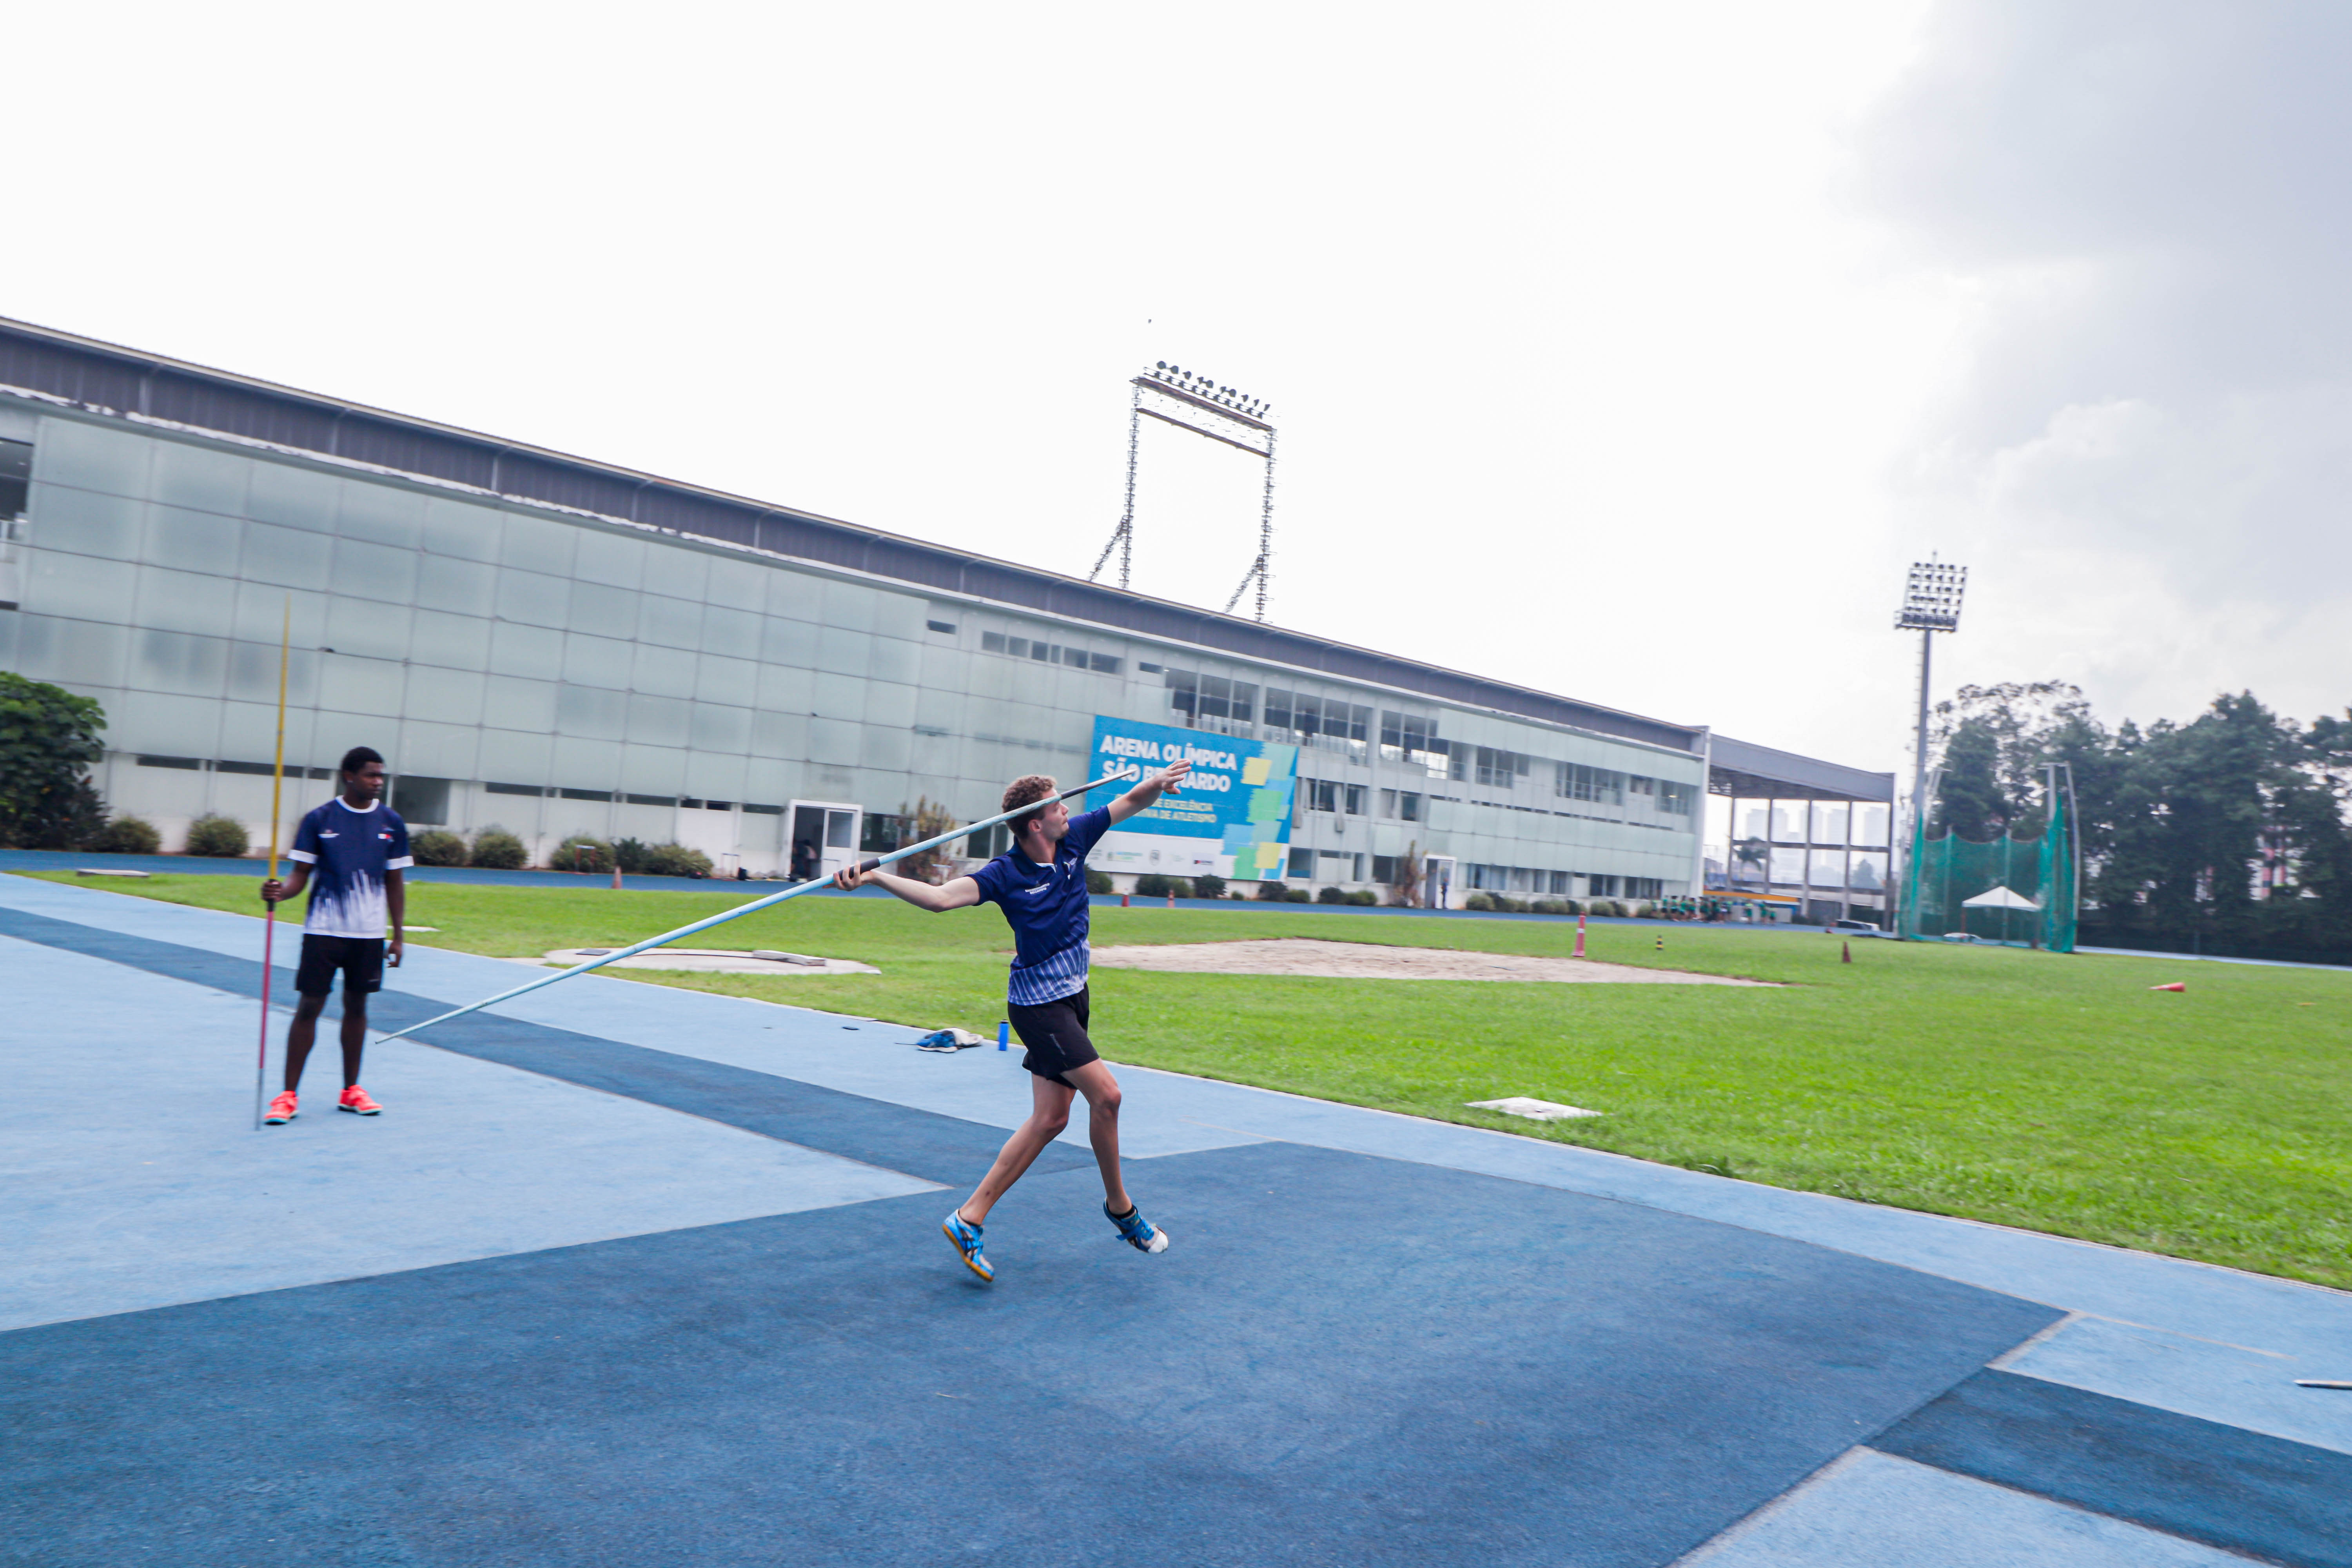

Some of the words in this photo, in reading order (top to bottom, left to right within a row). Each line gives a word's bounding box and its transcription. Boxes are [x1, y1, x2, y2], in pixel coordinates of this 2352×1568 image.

[1099, 735, 1160, 760] ARENA
[1162, 742, 1237, 771] OLÍMPICA
[1102, 757, 1141, 782] SÃO
[1142, 765, 1232, 792] BNARDO
